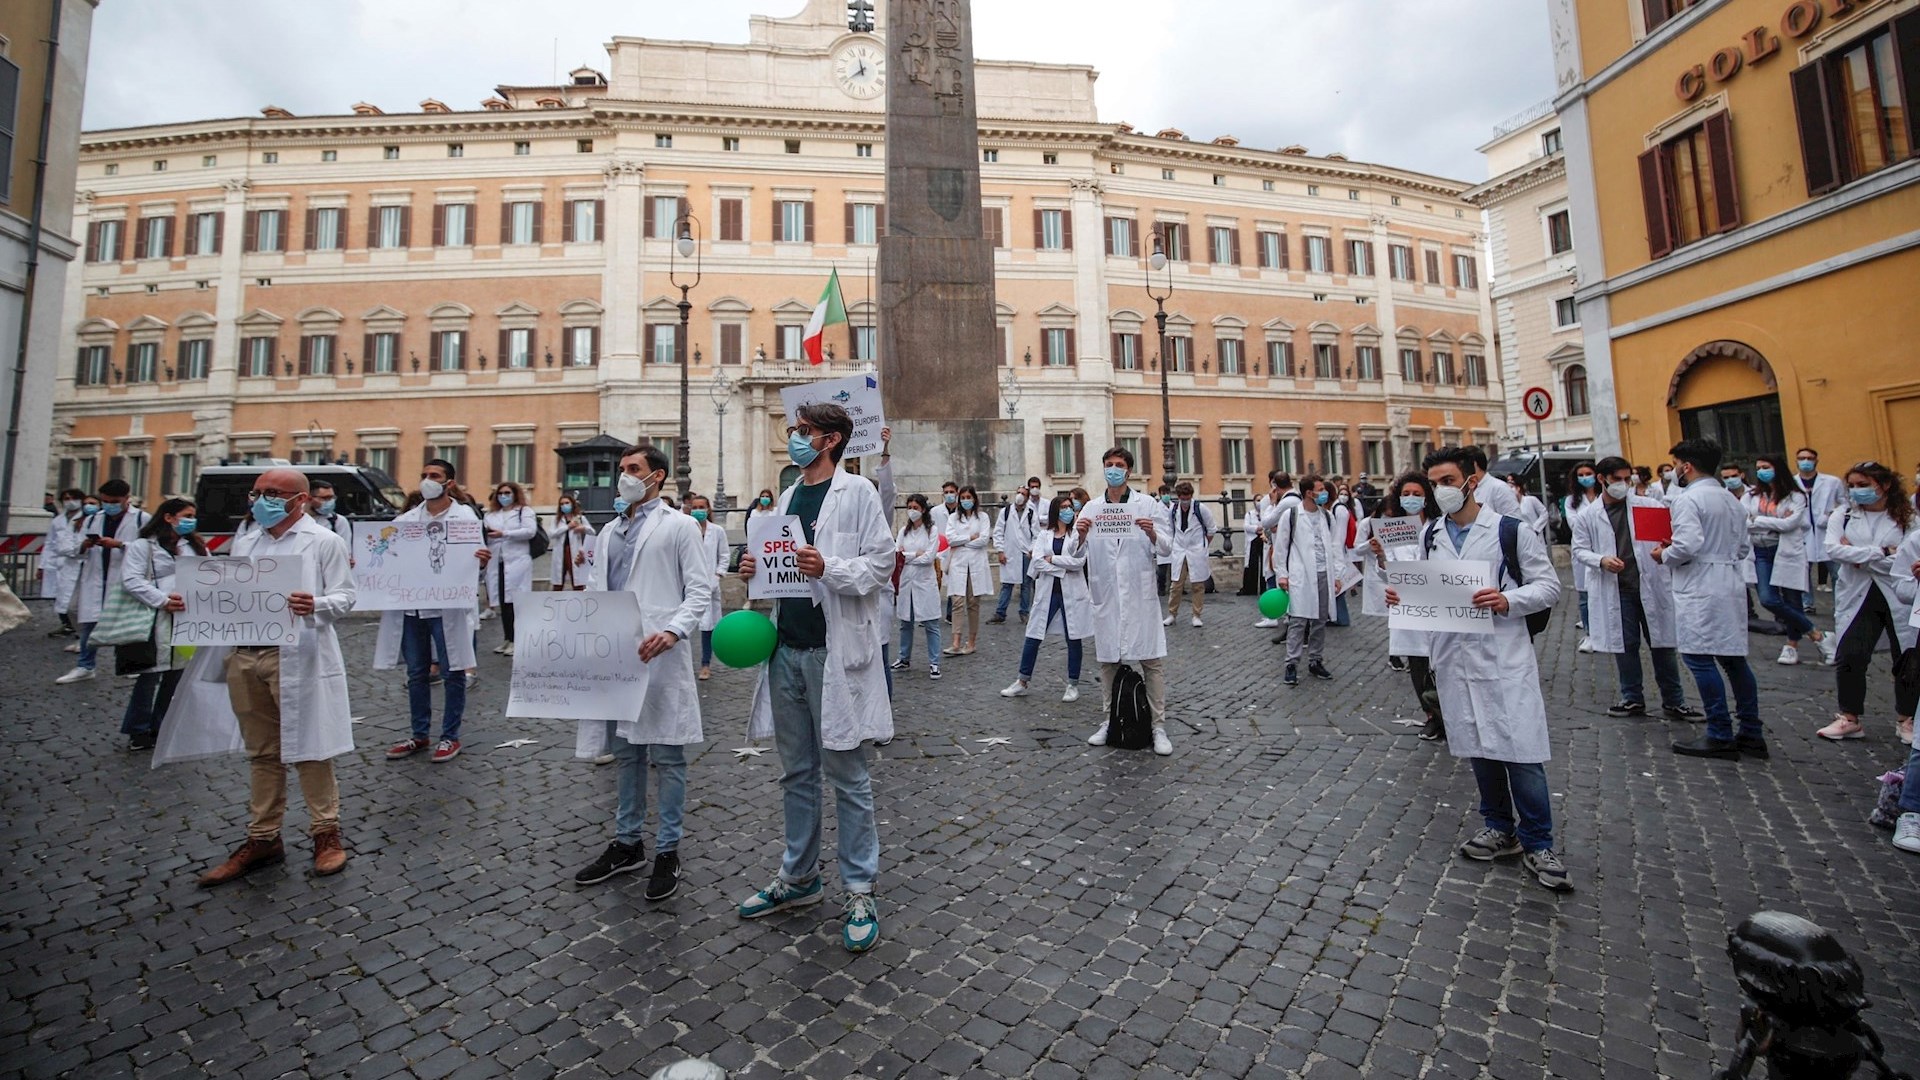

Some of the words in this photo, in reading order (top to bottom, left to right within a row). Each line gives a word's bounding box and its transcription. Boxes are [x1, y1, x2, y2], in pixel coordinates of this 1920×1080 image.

[854, 415, 880, 427] EUROPEI
[1378, 525, 1417, 534] SPECIALISTI
[1384, 520, 1407, 528] SENZA
[1387, 530, 1417, 538] CURANO
[763, 557, 778, 568] VI
[195, 557, 277, 586] STOP
[768, 572, 772, 584] I
[777, 571, 809, 584] MINI
[1389, 573, 1428, 586] STESSI
[1440, 573, 1484, 586] RISCHI
[186, 590, 287, 614] IMBUTO
[543, 596, 599, 622] STOP
[1391, 605, 1438, 618] STESSE
[521, 629, 622, 664] IMBUTO!
